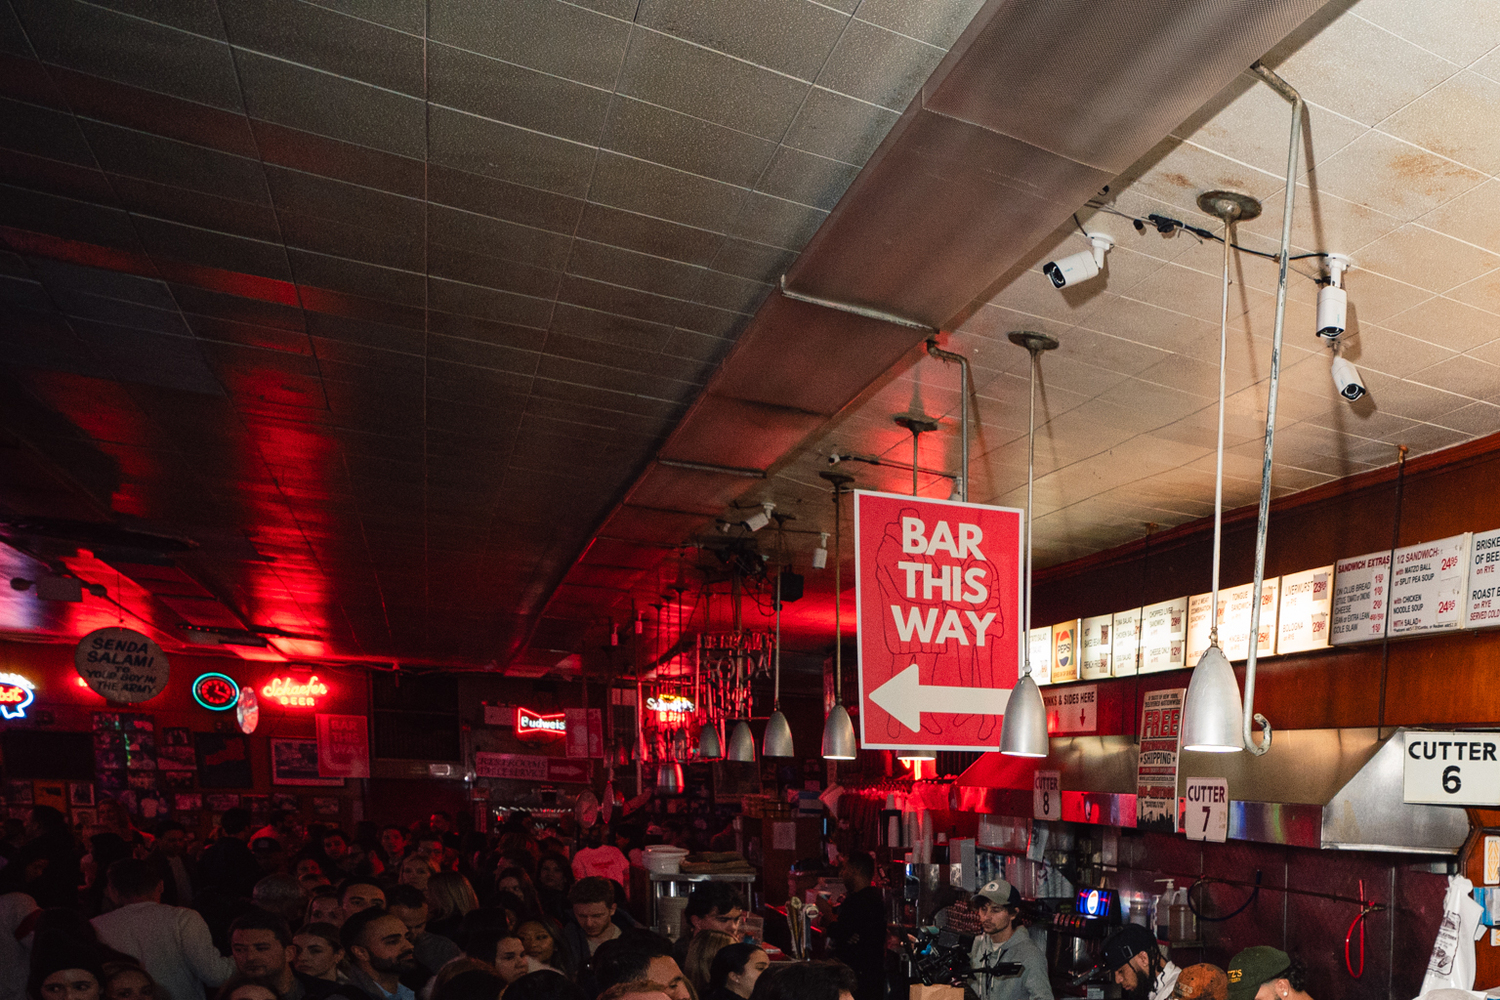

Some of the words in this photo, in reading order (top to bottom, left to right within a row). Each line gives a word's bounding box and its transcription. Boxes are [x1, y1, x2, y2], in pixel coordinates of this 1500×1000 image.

[902, 516, 987, 561] BAR
[1337, 560, 1366, 574] SANDWICH
[1367, 555, 1391, 568] EXTRAS
[1475, 554, 1485, 565] OF
[1404, 565, 1419, 574] MATZO
[1420, 563, 1431, 571] BALL
[1484, 565, 1495, 573] RYE
[898, 561, 988, 604] THIS
[1400, 577, 1412, 585] SPLIT
[1412, 575, 1421, 583] PEA
[1421, 573, 1435, 582] SOUP
[1284, 580, 1314, 597] LIVERWURST
[1355, 582, 1371, 591] BREAD
[1472, 587, 1495, 600] ROAST
[1403, 594, 1422, 603] CHICKEN
[1481, 600, 1491, 608] RYE
[1334, 605, 1351, 615] CHEESE
[1393, 605, 1411, 614] NOODLE
[1411, 603, 1423, 612] SOUP
[1470, 611, 1487, 621] SERVED
[1488, 609, 1500, 619] COLD
[890, 605, 997, 647] WAY
[1283, 622, 1304, 634] BOLOGNA
[87, 652, 155, 668] SALAMI
[97, 681, 118, 692] THE
[121, 682, 156, 695] ARMY
[262, 675, 328, 698] Schaefer
[280, 696, 315, 706] BEER
[1043, 695, 1058, 706] RINKS
[1063, 693, 1080, 704] SIDES
[1080, 691, 1095, 703] HERE
[520, 716, 566, 731] Budweis
[1142, 708, 1180, 739] FREE
[1408, 740, 1497, 762] CUTTER
[1143, 752, 1172, 765] SHIPPING
[1035, 776, 1058, 790] CUTTER
[1441, 765, 1462, 794] 6
[1187, 785, 1225, 803] CUTTER
[1043, 791, 1049, 815] 8
[1201, 805, 1211, 832] 7
